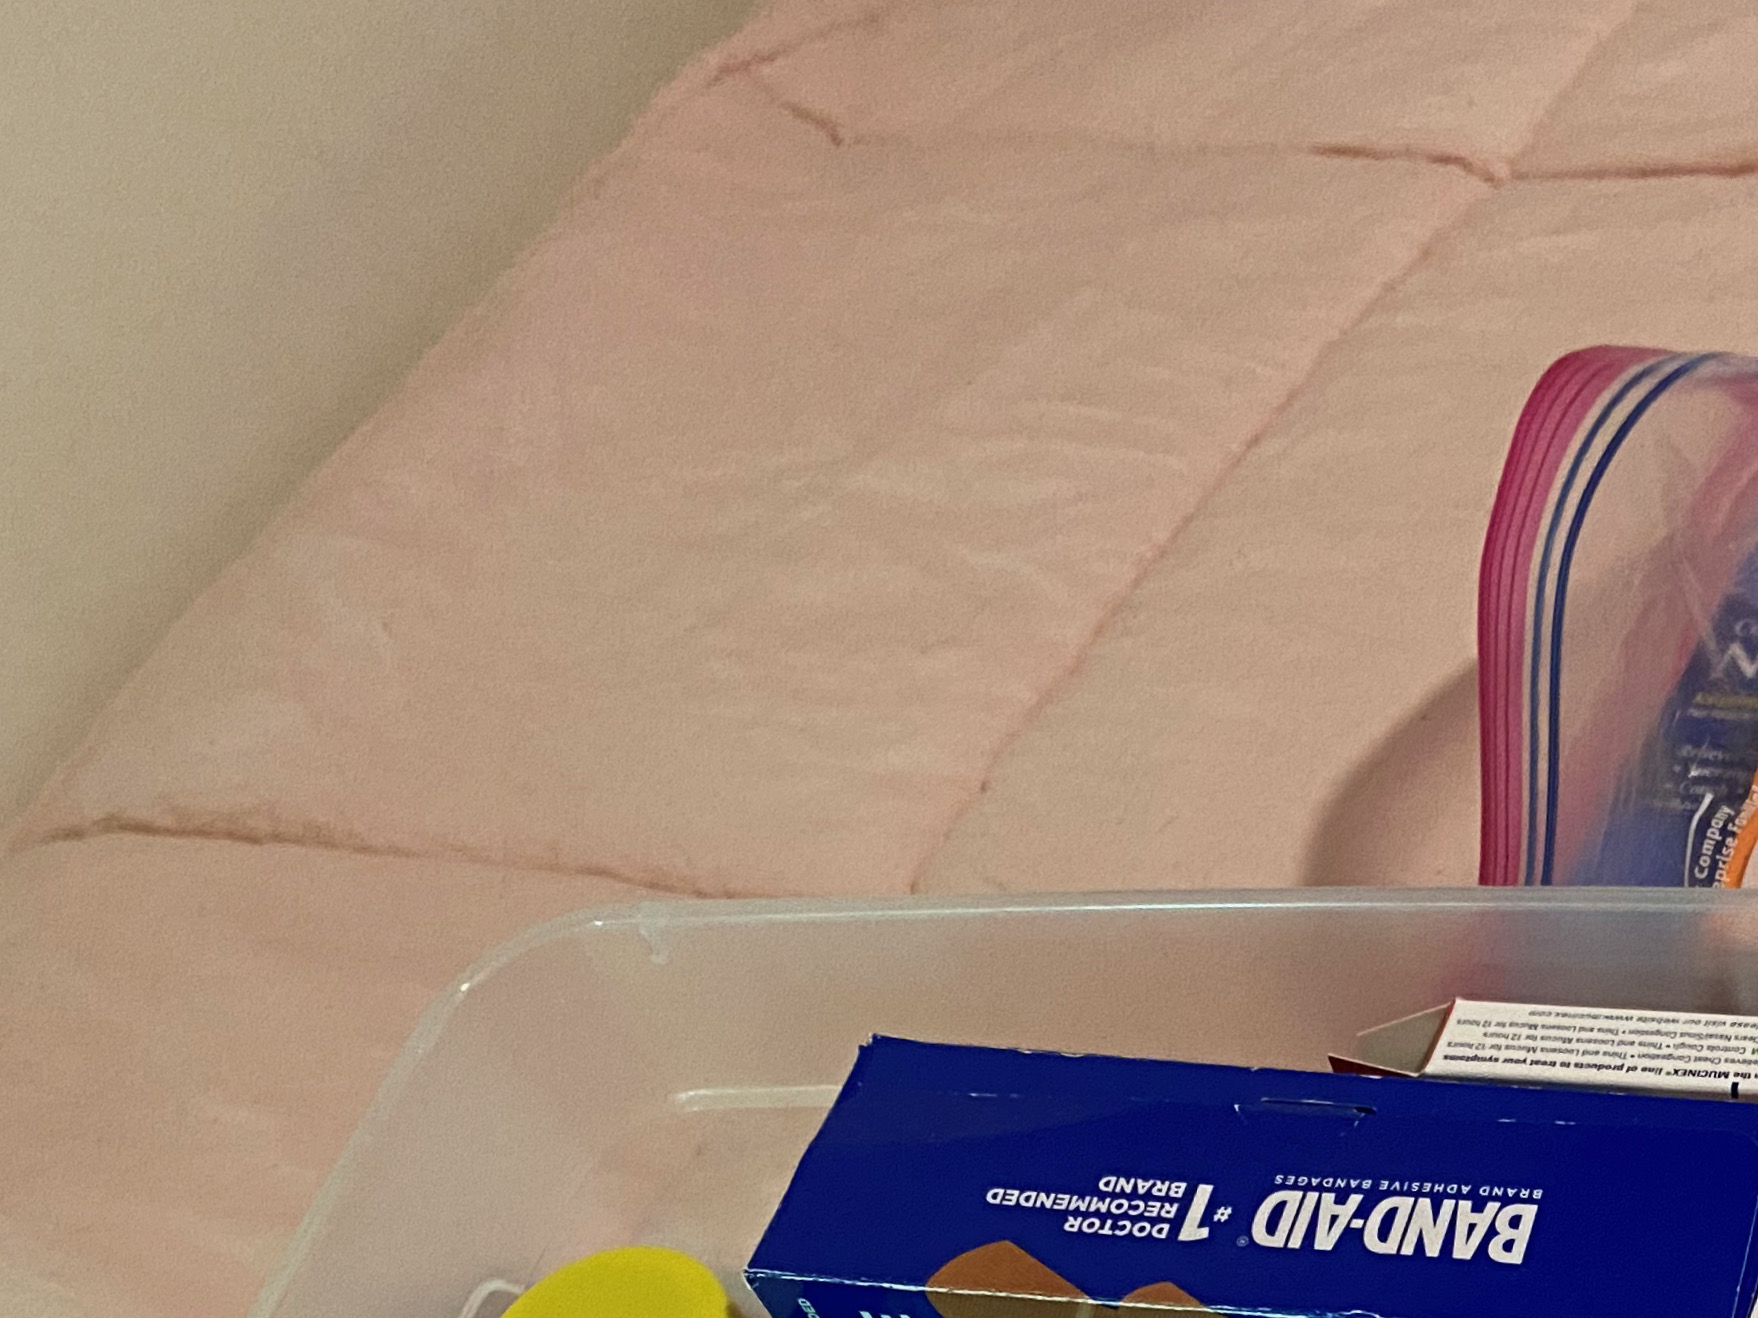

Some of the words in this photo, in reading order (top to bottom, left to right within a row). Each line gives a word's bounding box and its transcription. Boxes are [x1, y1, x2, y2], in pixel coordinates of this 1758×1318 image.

[1695, 805, 1735, 880] Company
[1574, 1061, 1625, 1074] products
[1098, 1175, 1188, 1199] BRAND
[1274, 1173, 1374, 1191] BANDAGES
[1378, 1180, 1473, 1197] ADHESIVE
[1479, 1185, 1544, 1200] BRAND
[986, 1187, 1180, 1220] RECOMMENDED
[1063, 1216, 1170, 1239] DOCTOR
